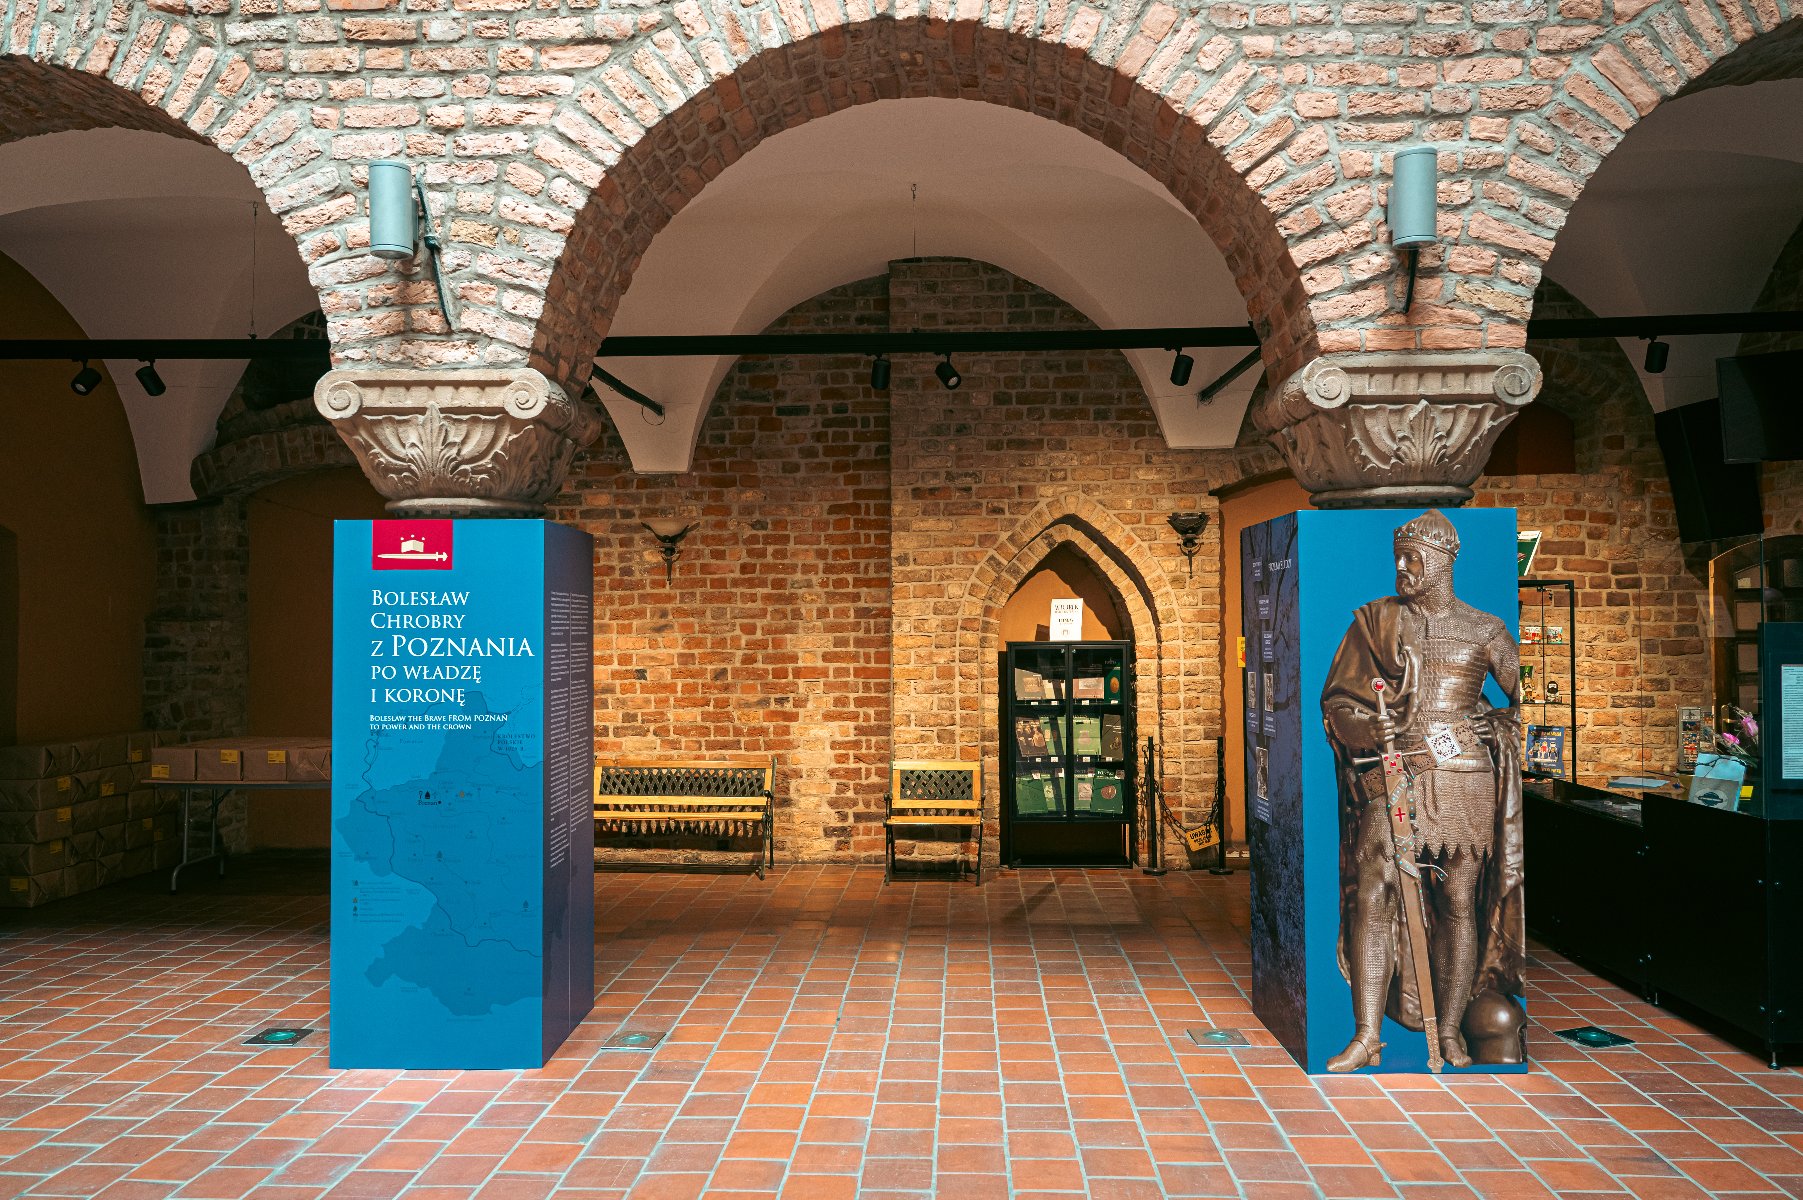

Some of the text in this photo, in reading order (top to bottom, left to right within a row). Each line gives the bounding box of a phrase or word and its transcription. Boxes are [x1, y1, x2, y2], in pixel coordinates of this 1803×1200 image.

[371, 589, 470, 606] BOLESŁAW
[370, 612, 466, 629] CHROBRY
[391, 634, 535, 657] POZNANIA
[371, 665, 482, 684] PO WŁADZĘ
[371, 688, 466, 707] I KORONĘ
[424, 714, 447, 722] BRAVE
[448, 714, 472, 722] FROM
